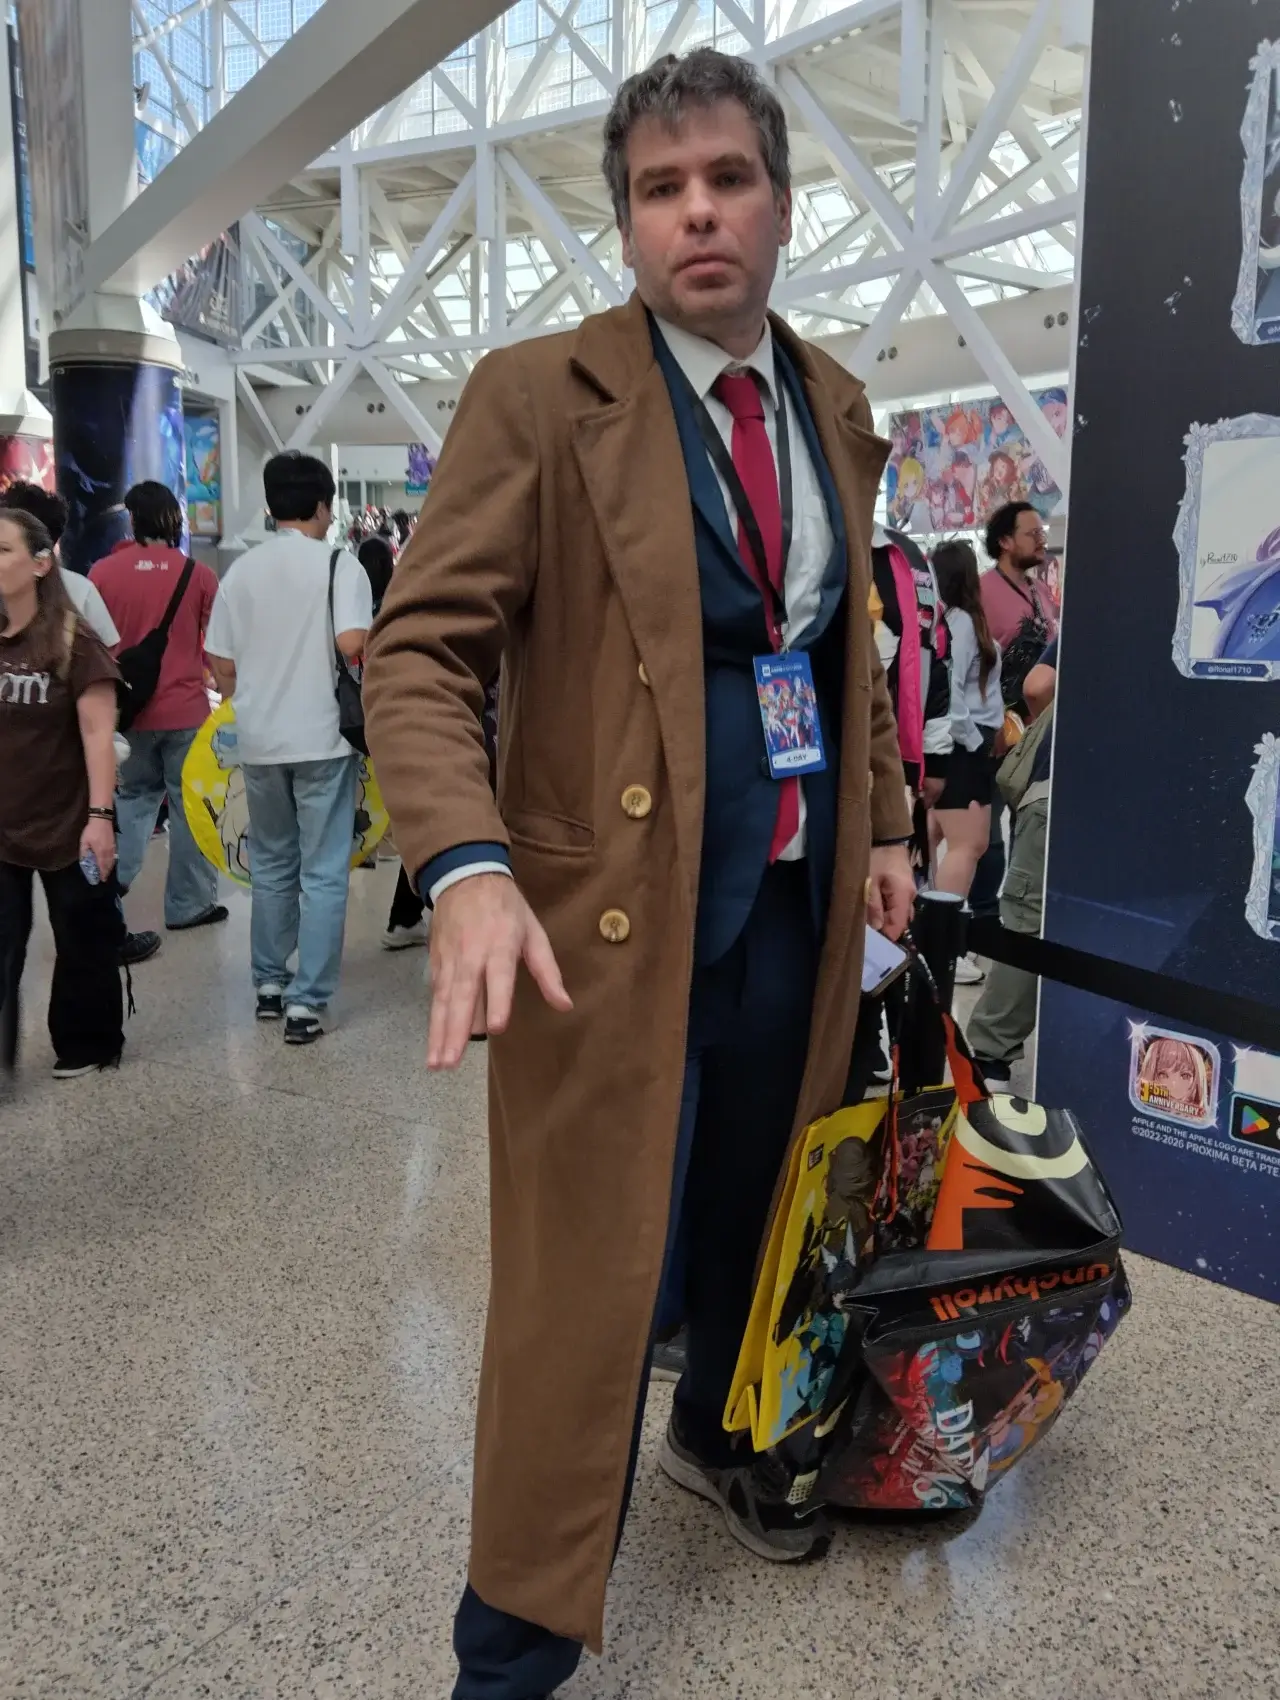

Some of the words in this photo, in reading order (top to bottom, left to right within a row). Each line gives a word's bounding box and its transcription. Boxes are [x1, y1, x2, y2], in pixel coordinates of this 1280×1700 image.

[1148, 1095, 1200, 1116] ANNIVERSARY
[1131, 1116, 1155, 1129] APPLE
[1156, 1123, 1172, 1133] AND
[1173, 1127, 1187, 1138] THE
[1188, 1132, 1213, 1145] APPLE
[1213, 1139, 1237, 1152] LOGO
[1237, 1146, 1255, 1158] ARE
[1185, 1142, 1230, 1163] PROXIMA
[1231, 1154, 1258, 1172] BETA
